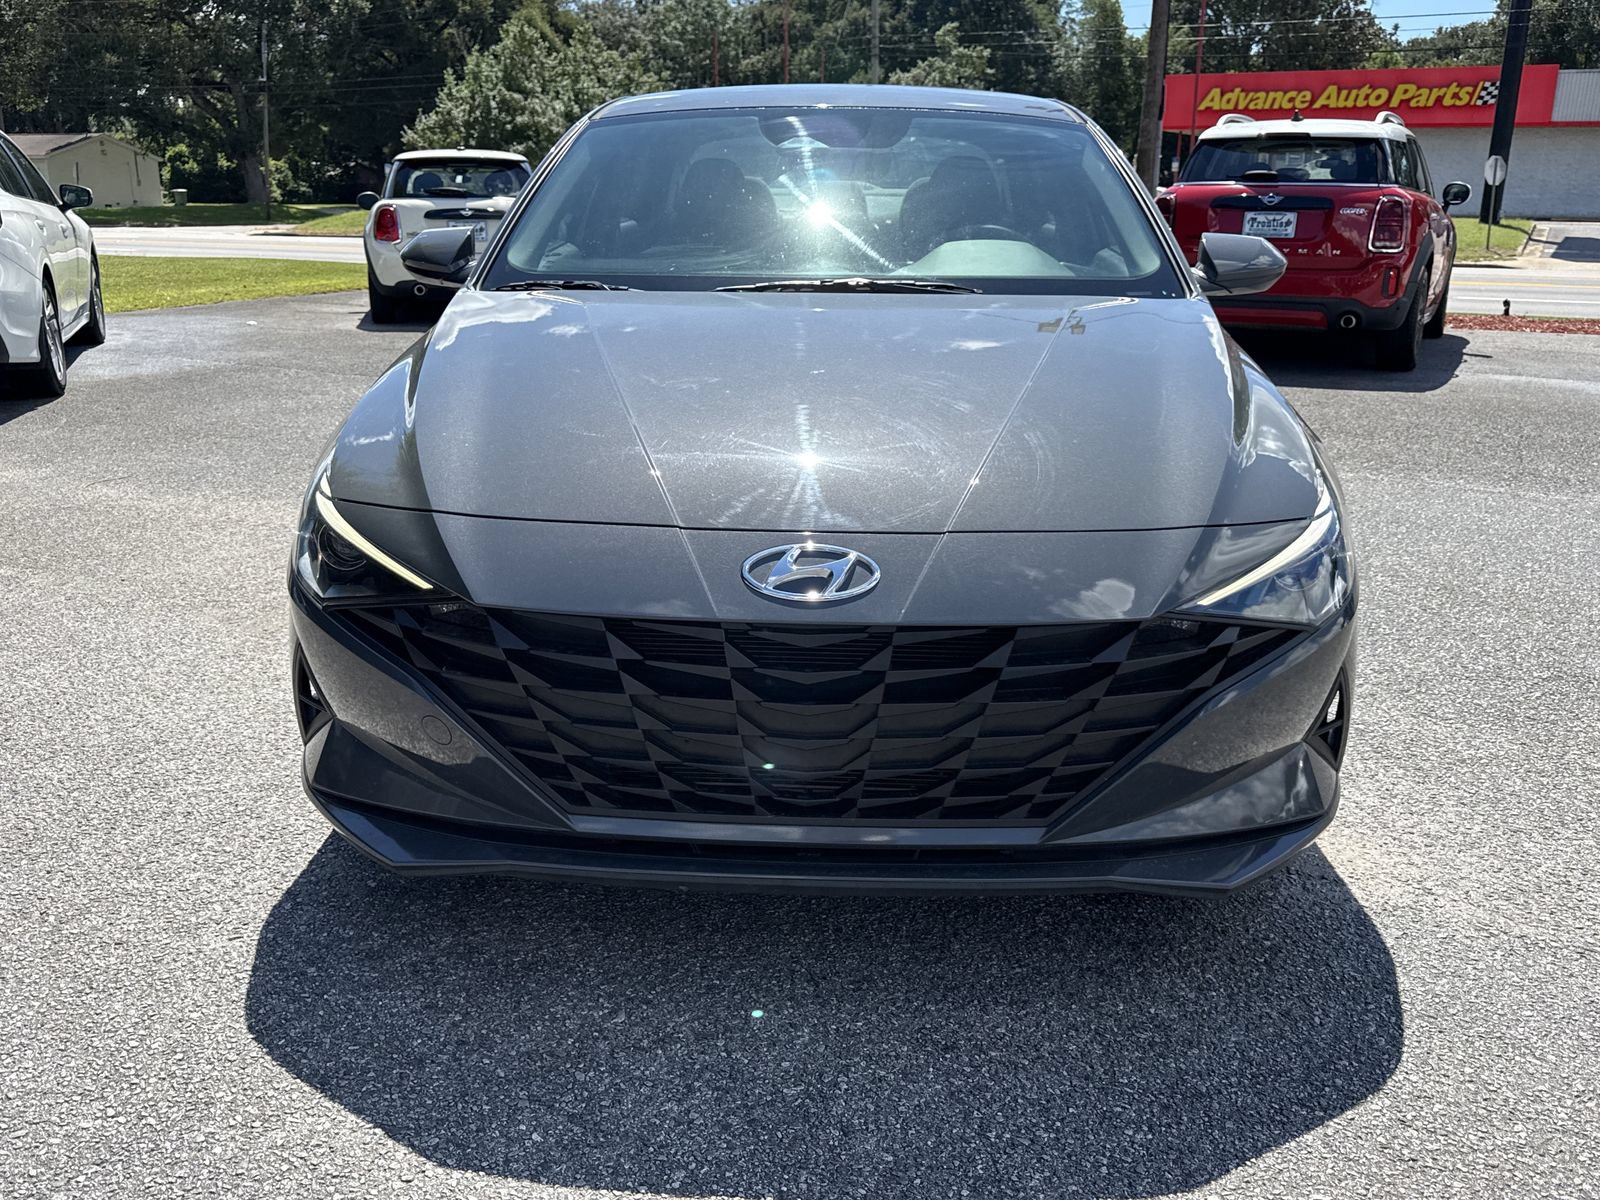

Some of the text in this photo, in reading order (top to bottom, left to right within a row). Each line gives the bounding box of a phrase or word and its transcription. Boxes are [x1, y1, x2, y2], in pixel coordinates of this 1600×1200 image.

[1198, 82, 1474, 110] Advance Auto Parts
